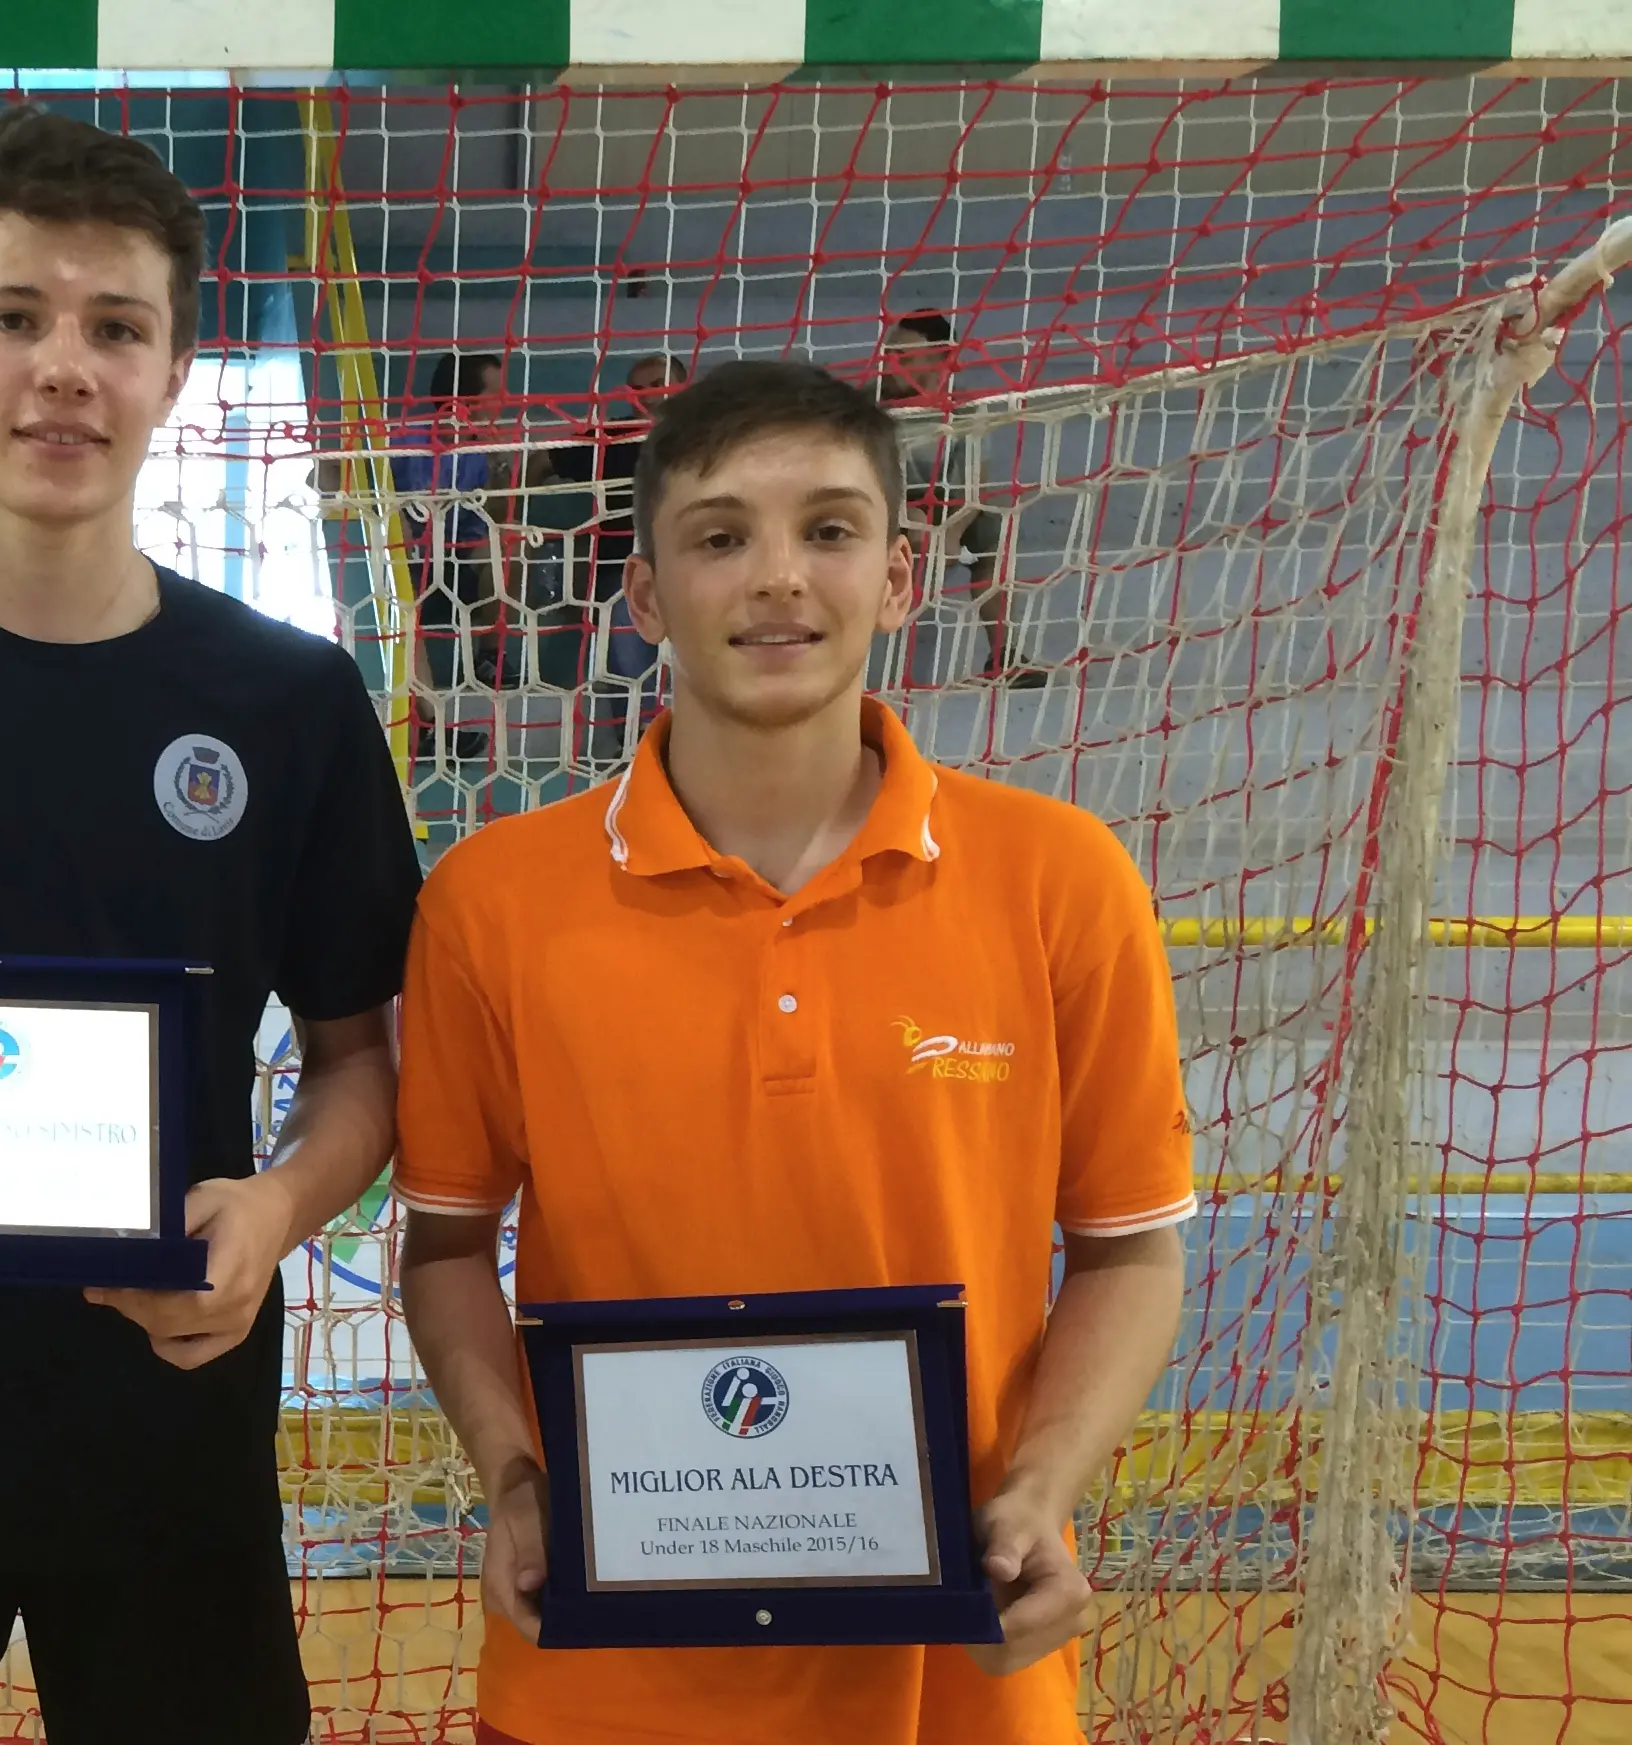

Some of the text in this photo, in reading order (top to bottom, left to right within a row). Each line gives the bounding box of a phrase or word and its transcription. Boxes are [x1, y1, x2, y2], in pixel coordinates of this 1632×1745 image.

[703, 1358, 787, 1434] FEDERAZIONE ITALIANA GIUOCO HANDBALL
[611, 1464, 898, 1493] MIGLIOR ALA DESTRA
[658, 1513, 856, 1531] FINALE NAZIONALE
[641, 1536, 878, 1555] Under 18 Maschile 2015/16
